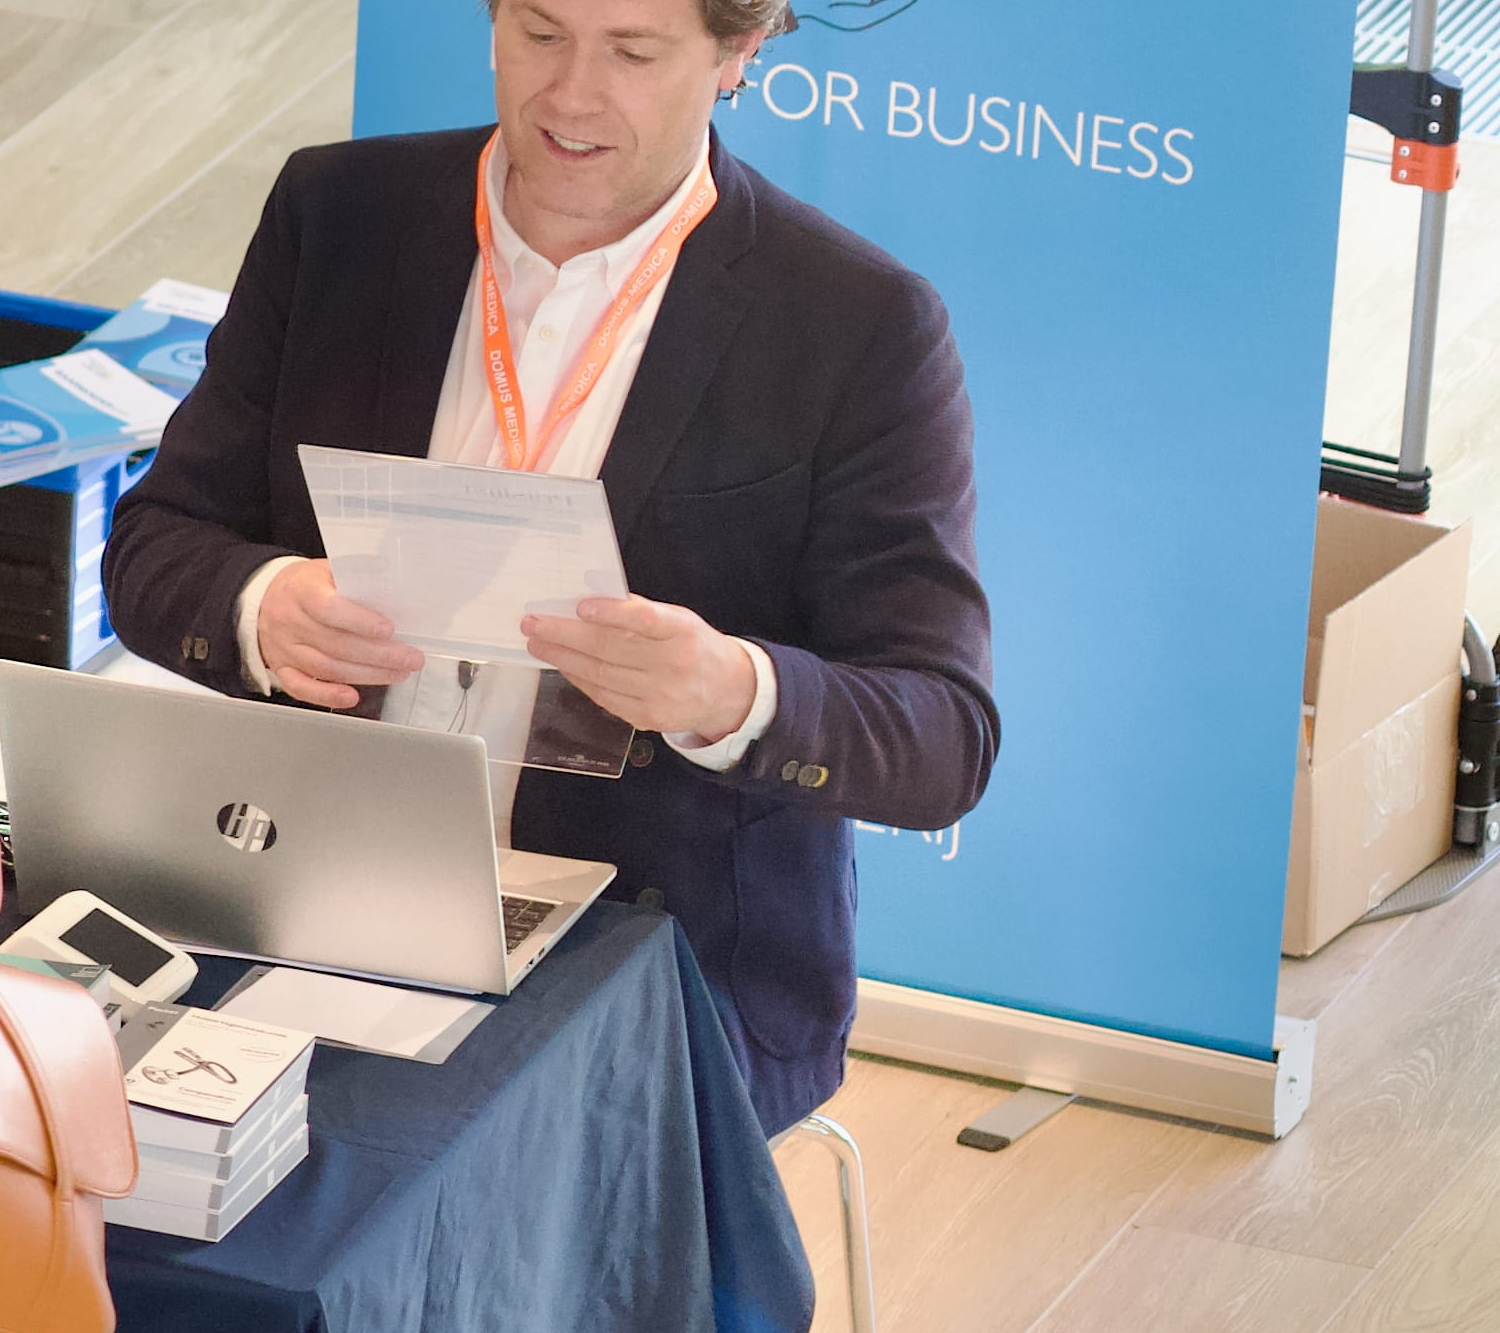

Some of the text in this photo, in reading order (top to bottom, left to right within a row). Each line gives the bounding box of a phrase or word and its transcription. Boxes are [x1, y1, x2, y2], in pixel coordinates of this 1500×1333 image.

[886, 80, 1197, 187] BUSINESS
[671, 186, 711, 236] DOMUS
[483, 279, 499, 337] MEDICA
[598, 246, 670, 348] DOMUS MEDICA
[490, 349, 514, 403] DOMUS
[221, 803, 272, 852] hp
